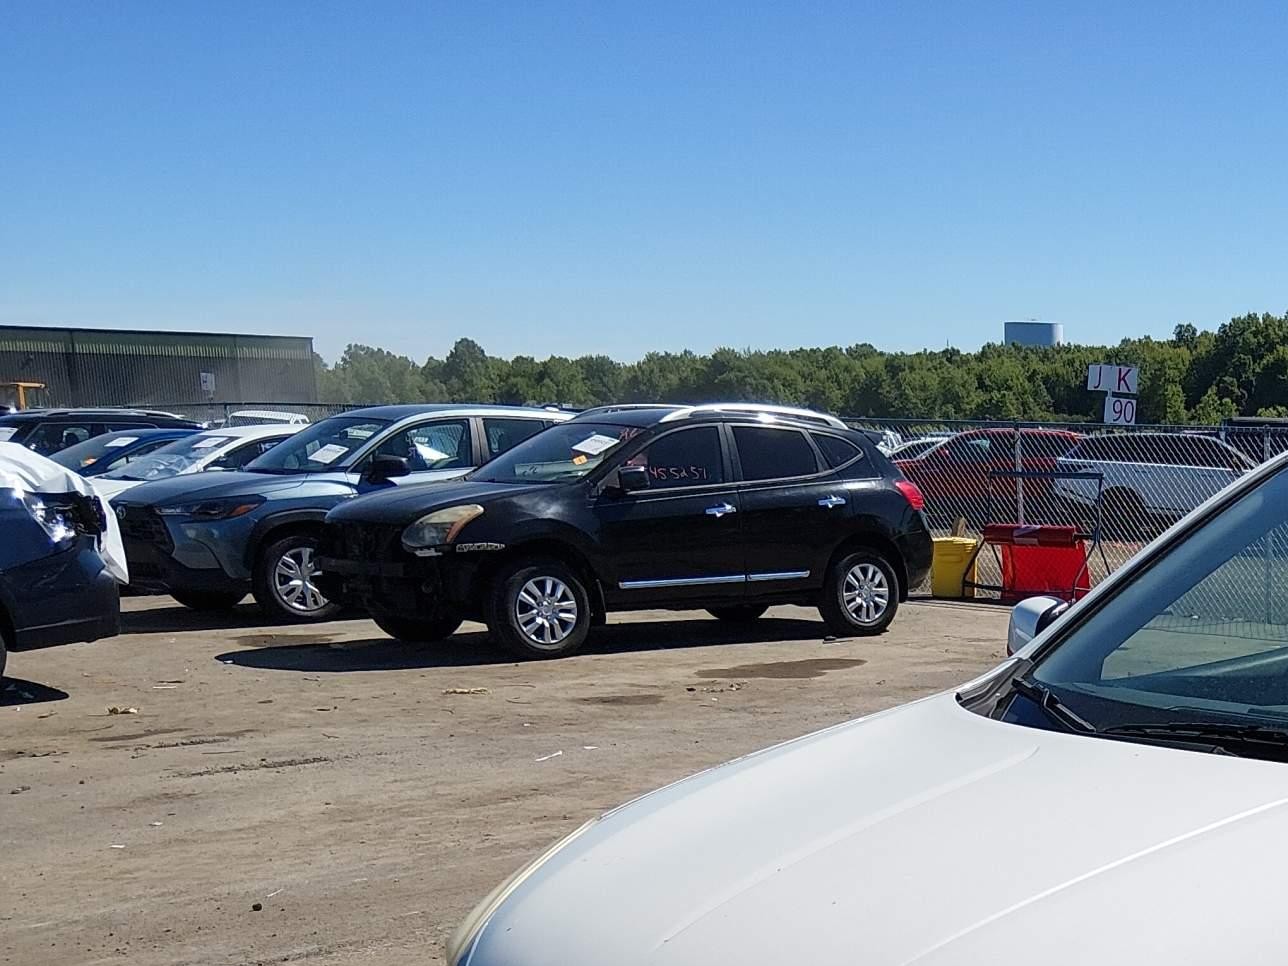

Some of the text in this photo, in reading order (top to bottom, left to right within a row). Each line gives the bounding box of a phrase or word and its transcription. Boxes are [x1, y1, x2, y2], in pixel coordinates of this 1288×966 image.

[1093, 366, 1132, 392] J K
[1112, 399, 1135, 423] 90
